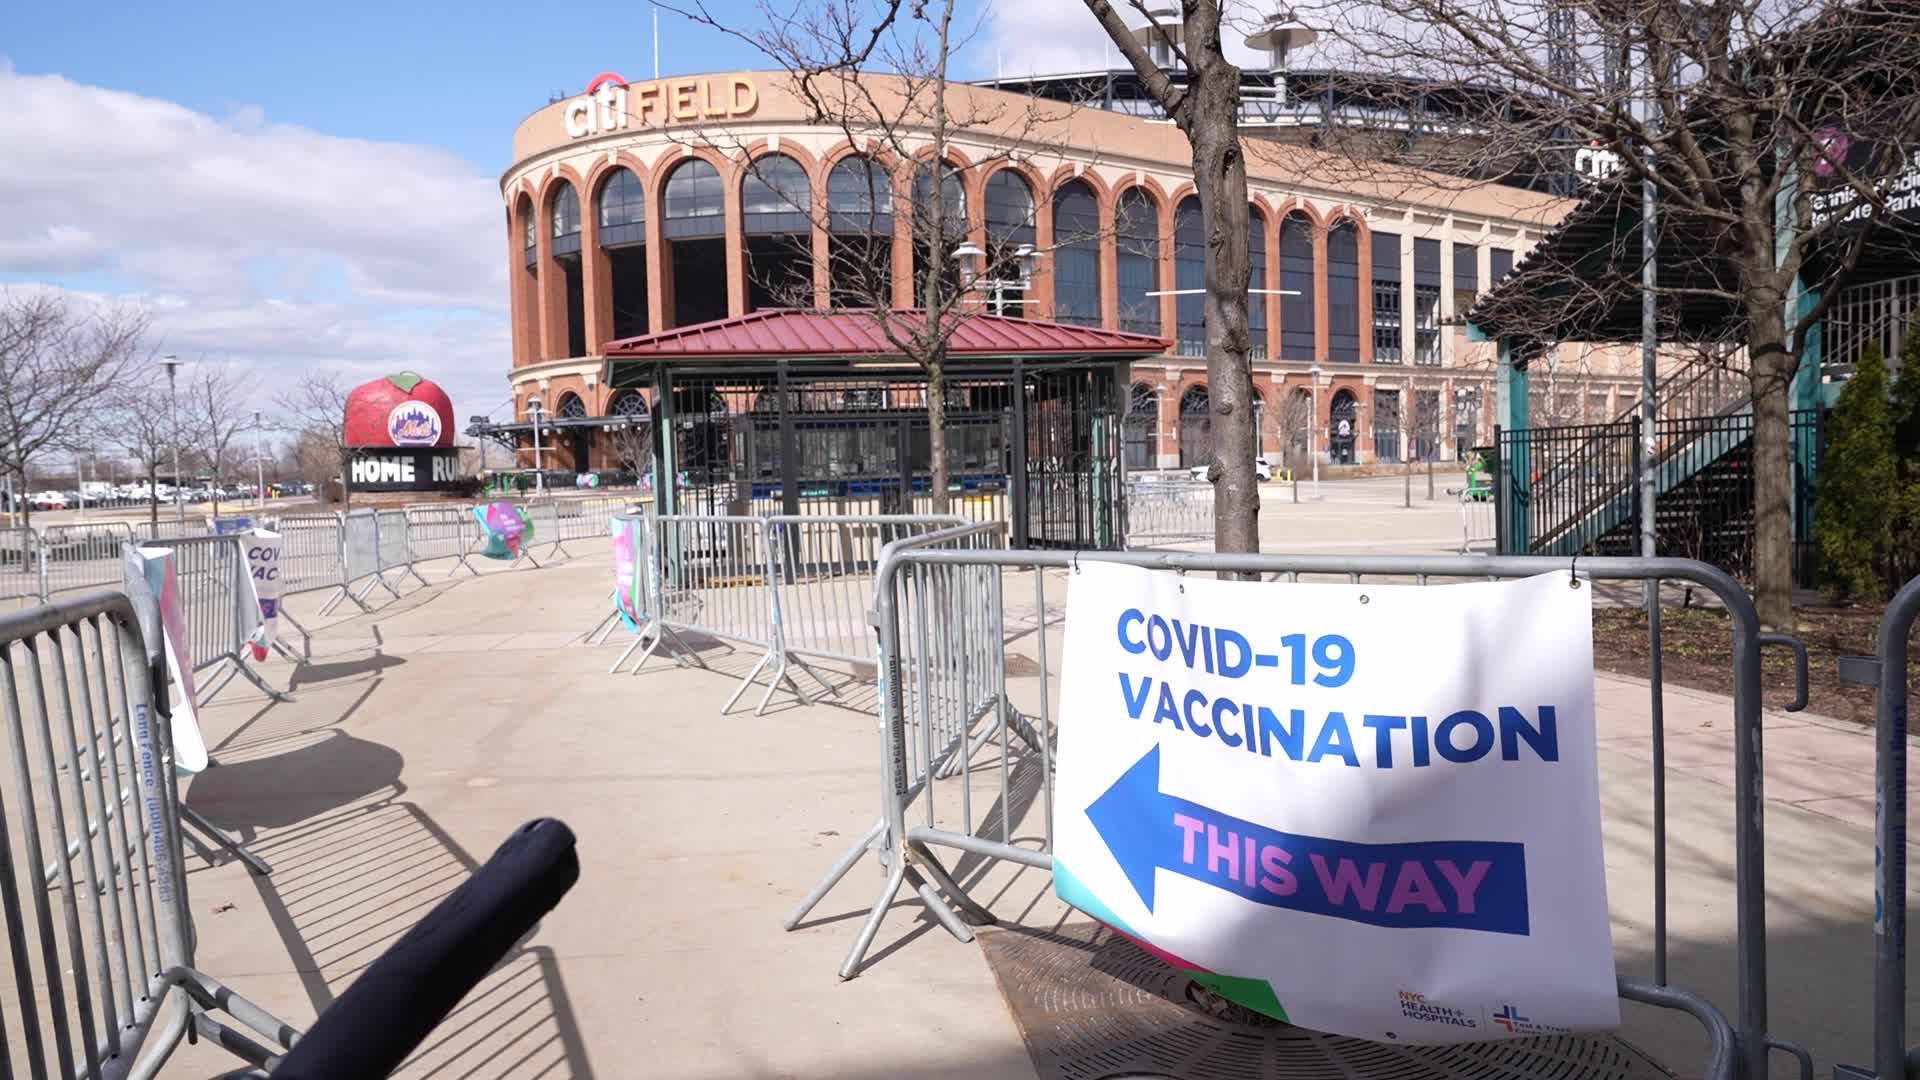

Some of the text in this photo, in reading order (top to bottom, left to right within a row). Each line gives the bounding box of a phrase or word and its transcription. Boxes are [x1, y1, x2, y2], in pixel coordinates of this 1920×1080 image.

[565, 77, 758, 139] citi FIELD
[352, 456, 415, 483] HOME
[1117, 608, 1356, 688] COVID-19
[1118, 671, 1559, 769] VACCINATION
[1174, 812, 1492, 914] THIS WAY
[1399, 992, 1425, 1003] NYC
[1402, 1010, 1477, 1028] HOSPITALS
